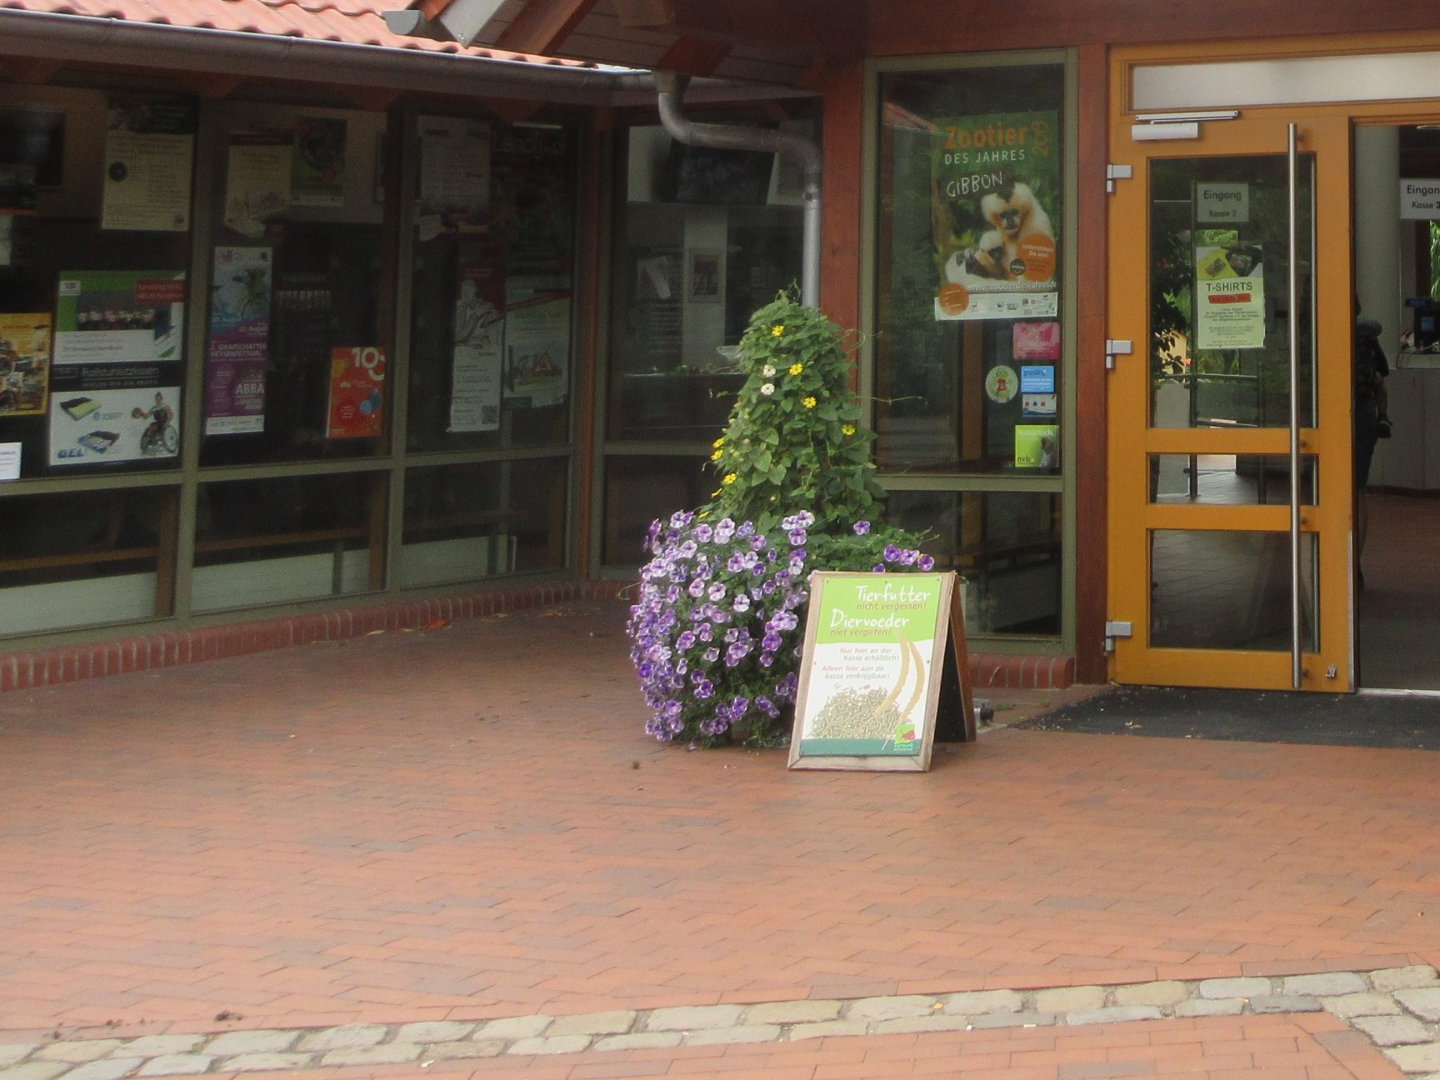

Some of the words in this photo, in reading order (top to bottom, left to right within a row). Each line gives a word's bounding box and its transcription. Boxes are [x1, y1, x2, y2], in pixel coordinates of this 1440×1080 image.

[944, 120, 1029, 151] Zootier
[944, 152, 969, 165] DES
[975, 149, 1026, 163] JAHRES
[946, 171, 1004, 197] GIBBON
[1203, 189, 1242, 202] Eingang
[1411, 201, 1434, 209] Kasse
[1206, 281, 1253, 292] T-SHIRTS
[235, 383, 265, 394] ABBA
[856, 583, 932, 602] Tierfutter
[856, 602, 879, 610] nicht
[881, 602, 927, 611] vergessen!
[830, 608, 910, 628] Diervoeder
[830, 627, 847, 636] niet
[849, 628, 892, 637] vergeten!
